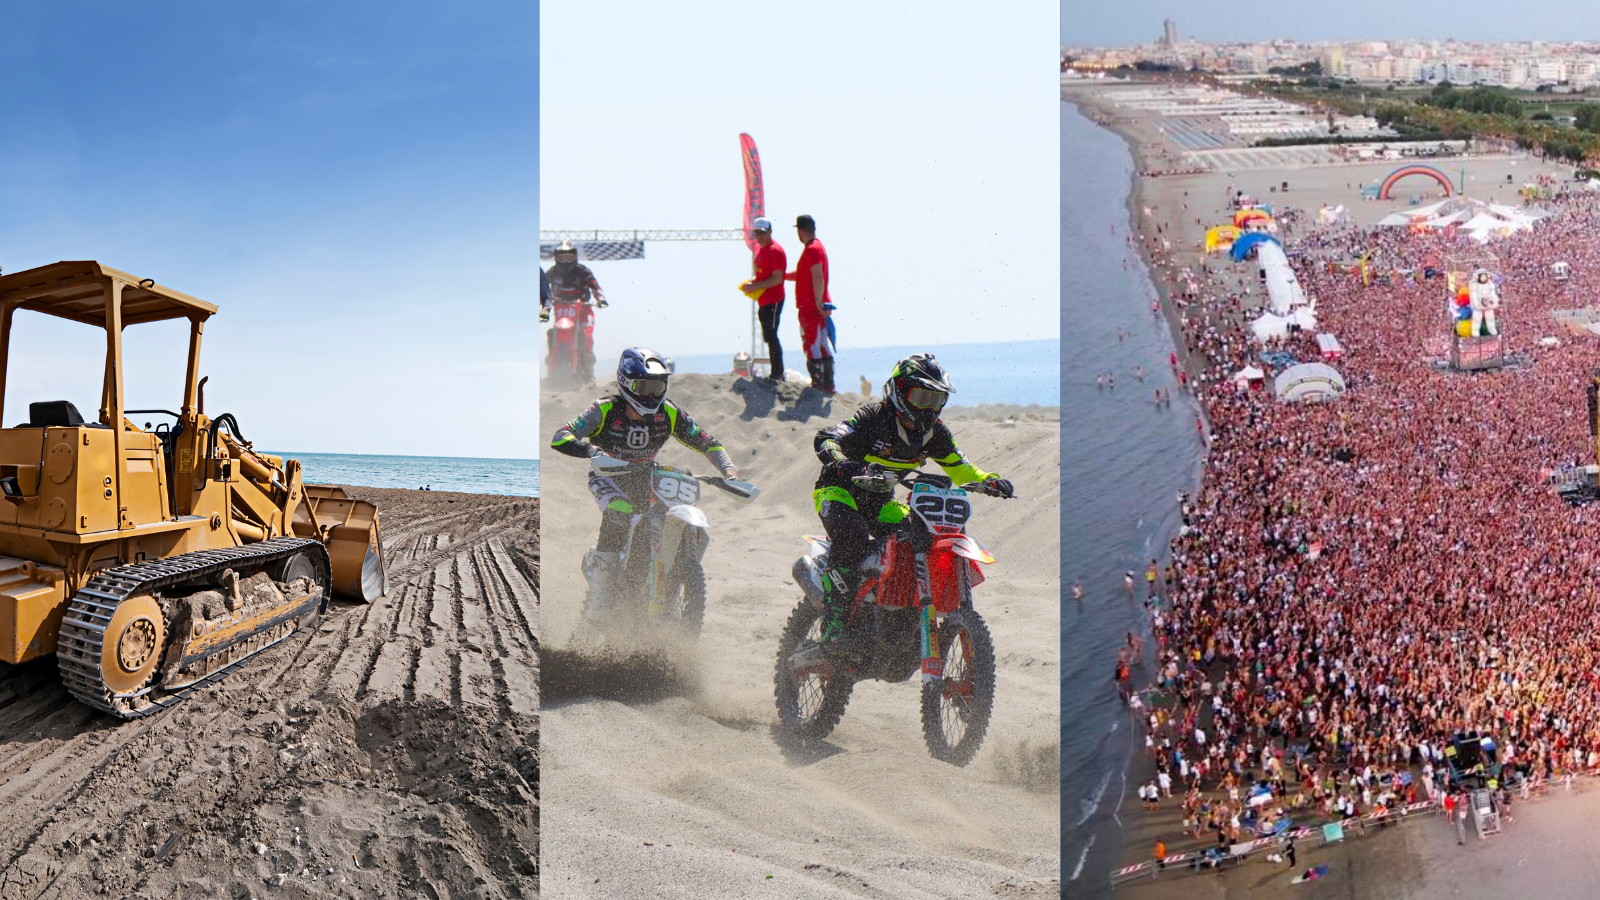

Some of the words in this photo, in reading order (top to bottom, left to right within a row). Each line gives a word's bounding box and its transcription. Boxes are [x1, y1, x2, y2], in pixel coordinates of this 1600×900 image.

[557, 308, 576, 317] 110
[657, 477, 698, 504] 95
[915, 495, 971, 525] 29
